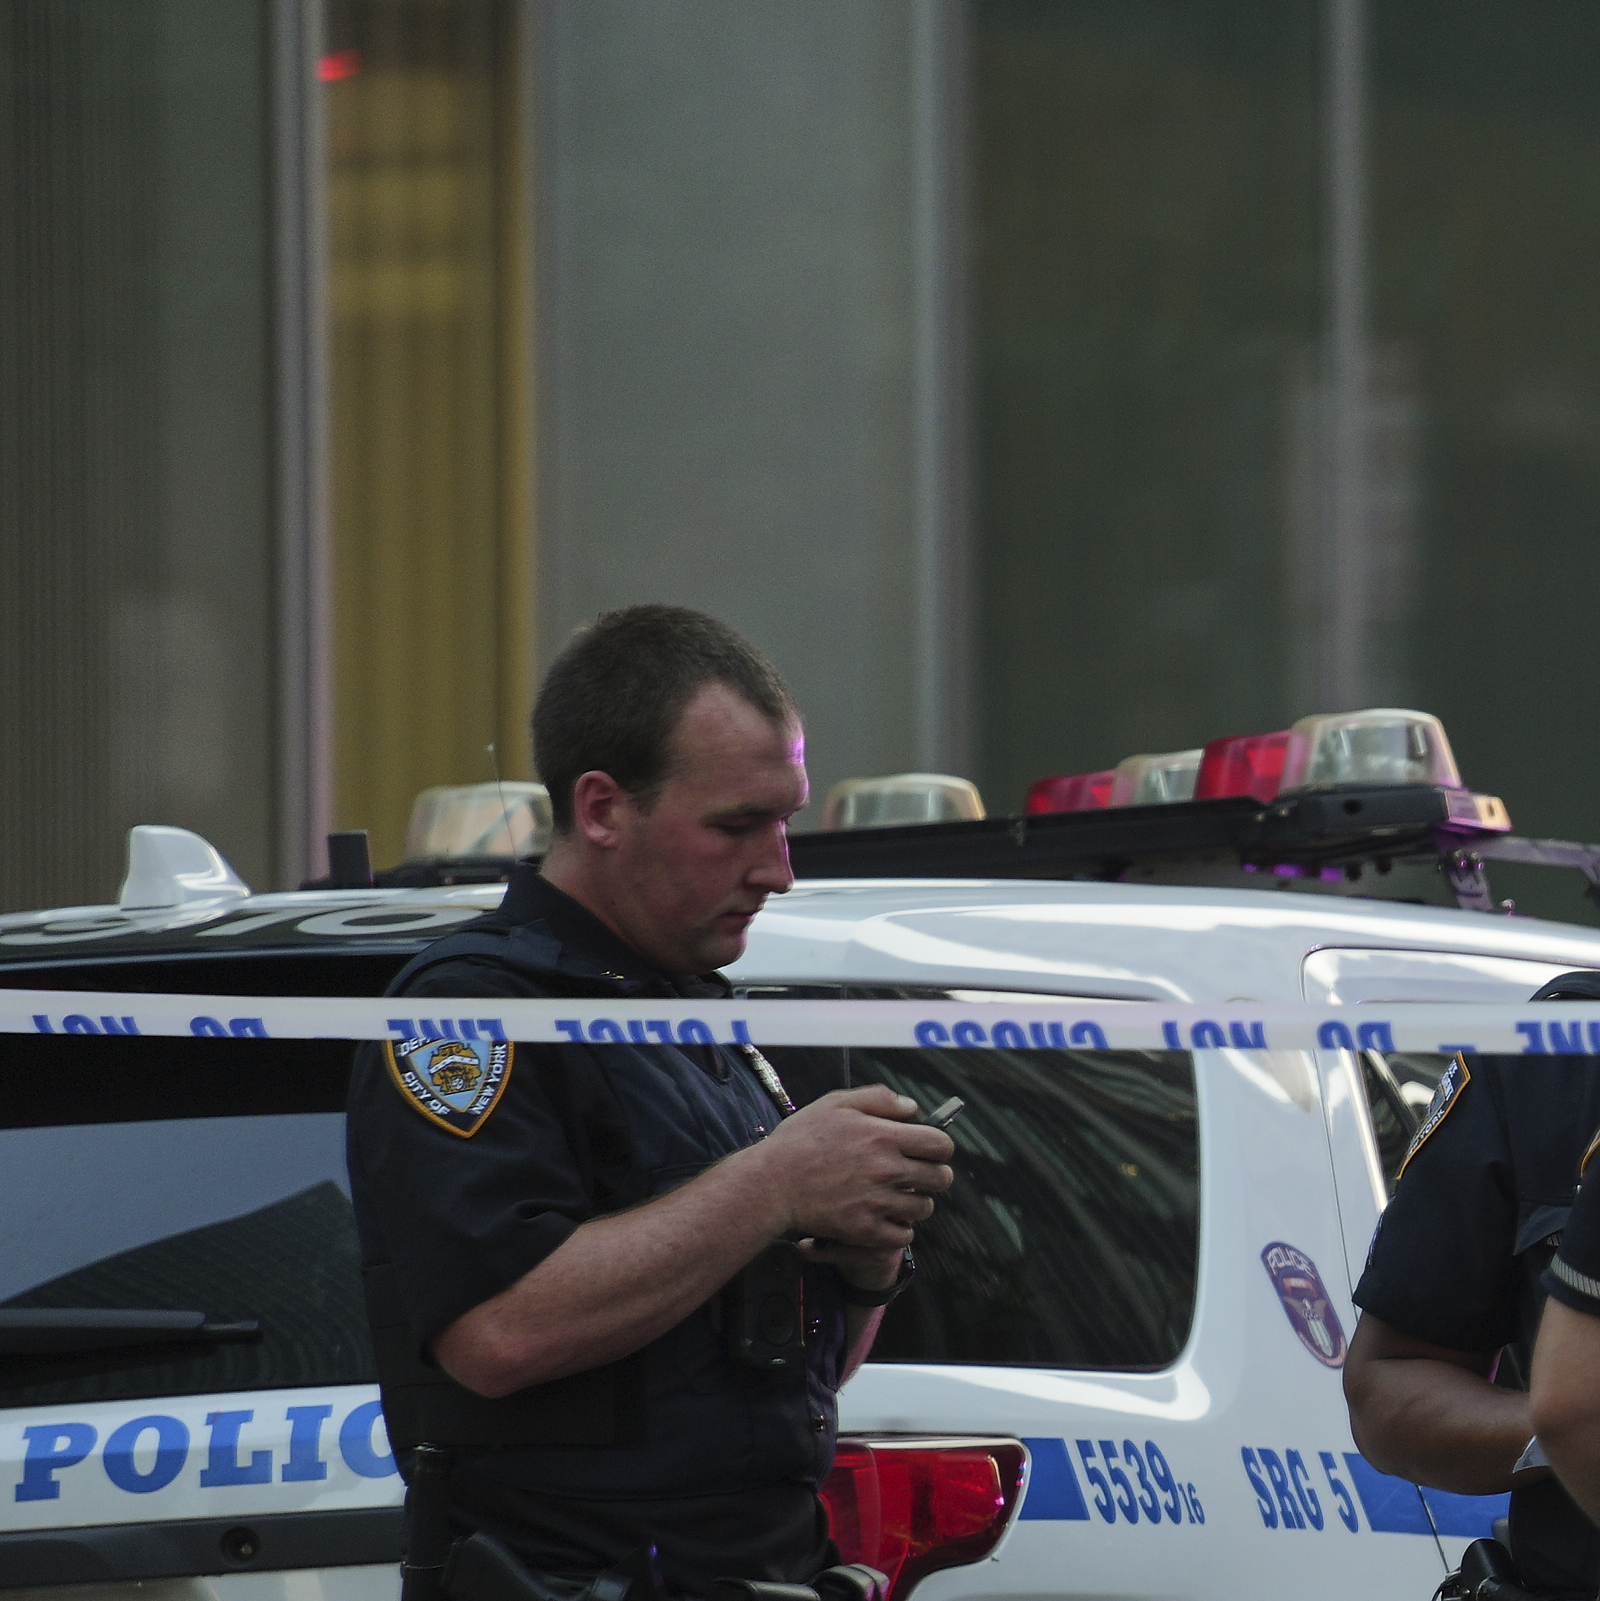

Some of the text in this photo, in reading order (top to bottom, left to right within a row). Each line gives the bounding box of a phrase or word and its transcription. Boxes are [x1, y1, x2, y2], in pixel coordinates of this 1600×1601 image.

[401, 1071, 451, 1115] CITY OF
[469, 1043, 507, 1116] NEW YORK
[1267, 1246, 1316, 1280] POLICE
[14, 1400, 399, 1503] POLIC
[1076, 1439, 1182, 1525] 5539
[1240, 1445, 1324, 1531] SRG
[1318, 1451, 1359, 1534] 5
